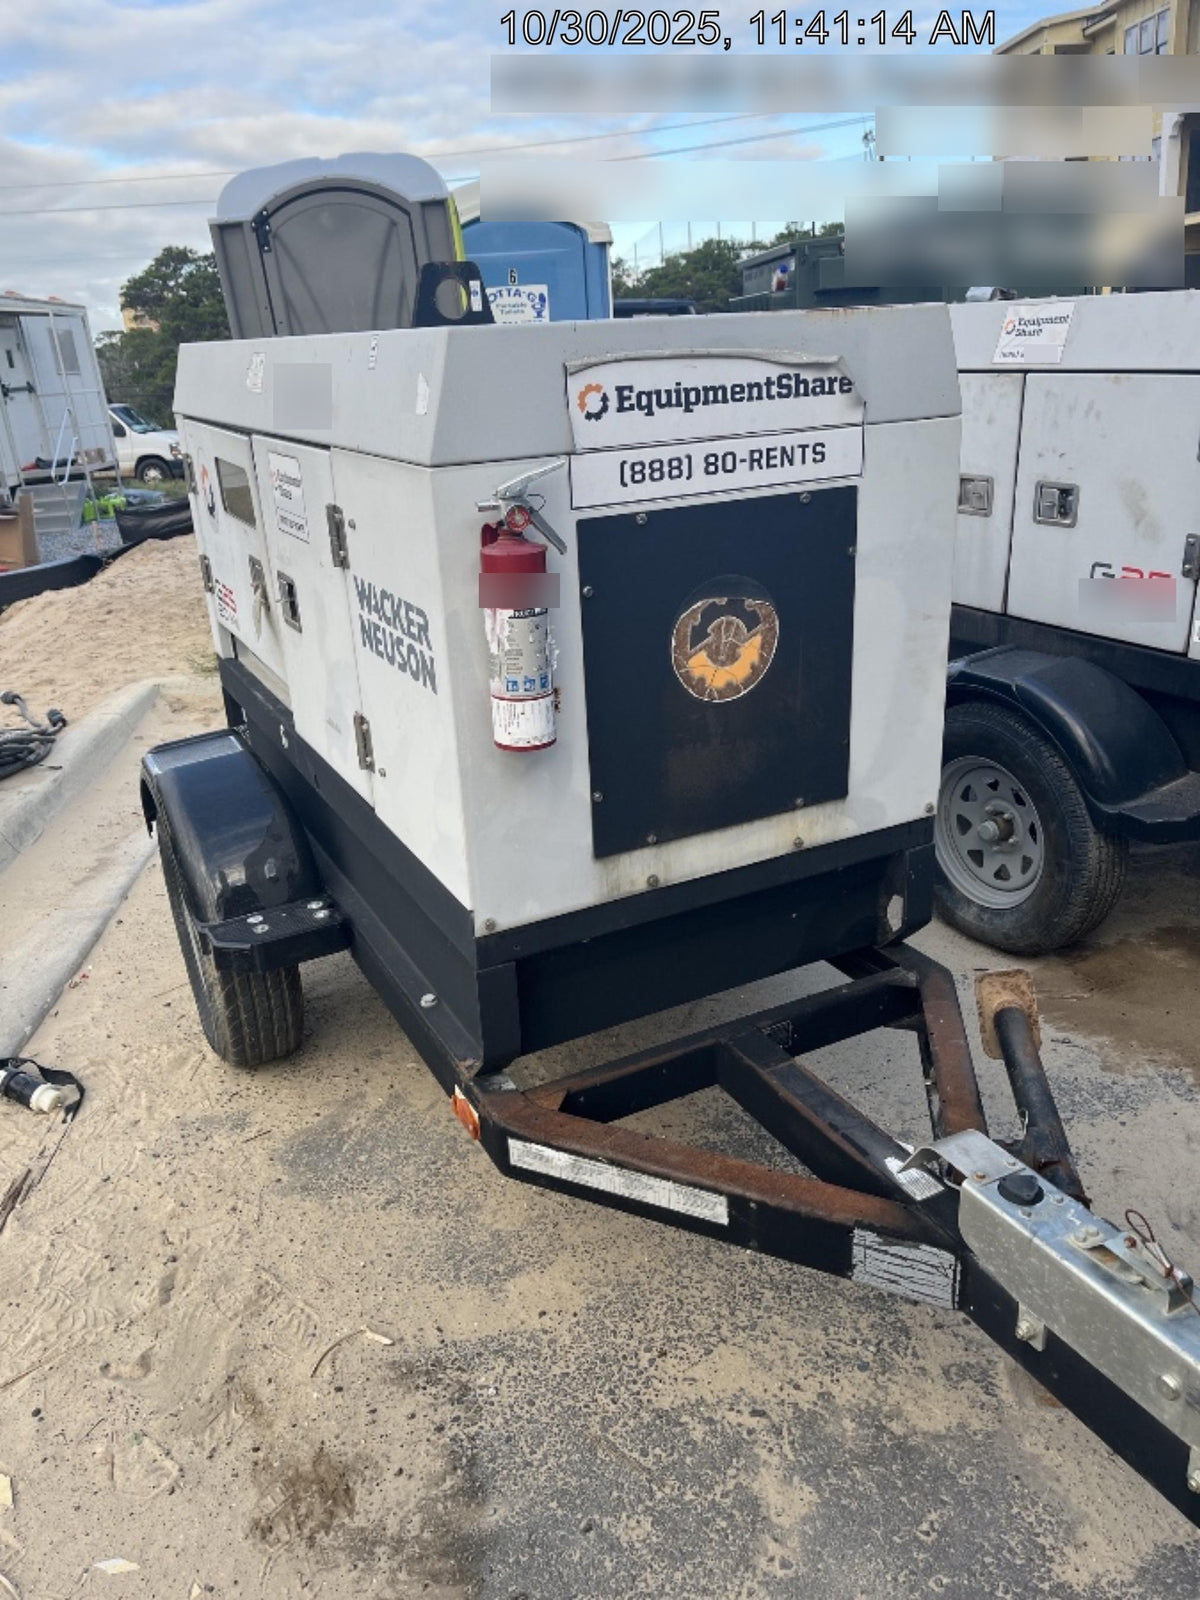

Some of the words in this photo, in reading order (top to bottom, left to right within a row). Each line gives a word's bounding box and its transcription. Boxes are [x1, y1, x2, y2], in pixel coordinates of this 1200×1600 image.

[509, 268, 517, 284] 6
[1015, 328, 1042, 337] Share
[615, 373, 852, 416] EquipmentShare
[620, 454, 692, 487] (888)
[704, 442, 826, 476] 80-RENTS
[353, 574, 433, 652] WACKER
[359, 613, 438, 696] NEUSON
